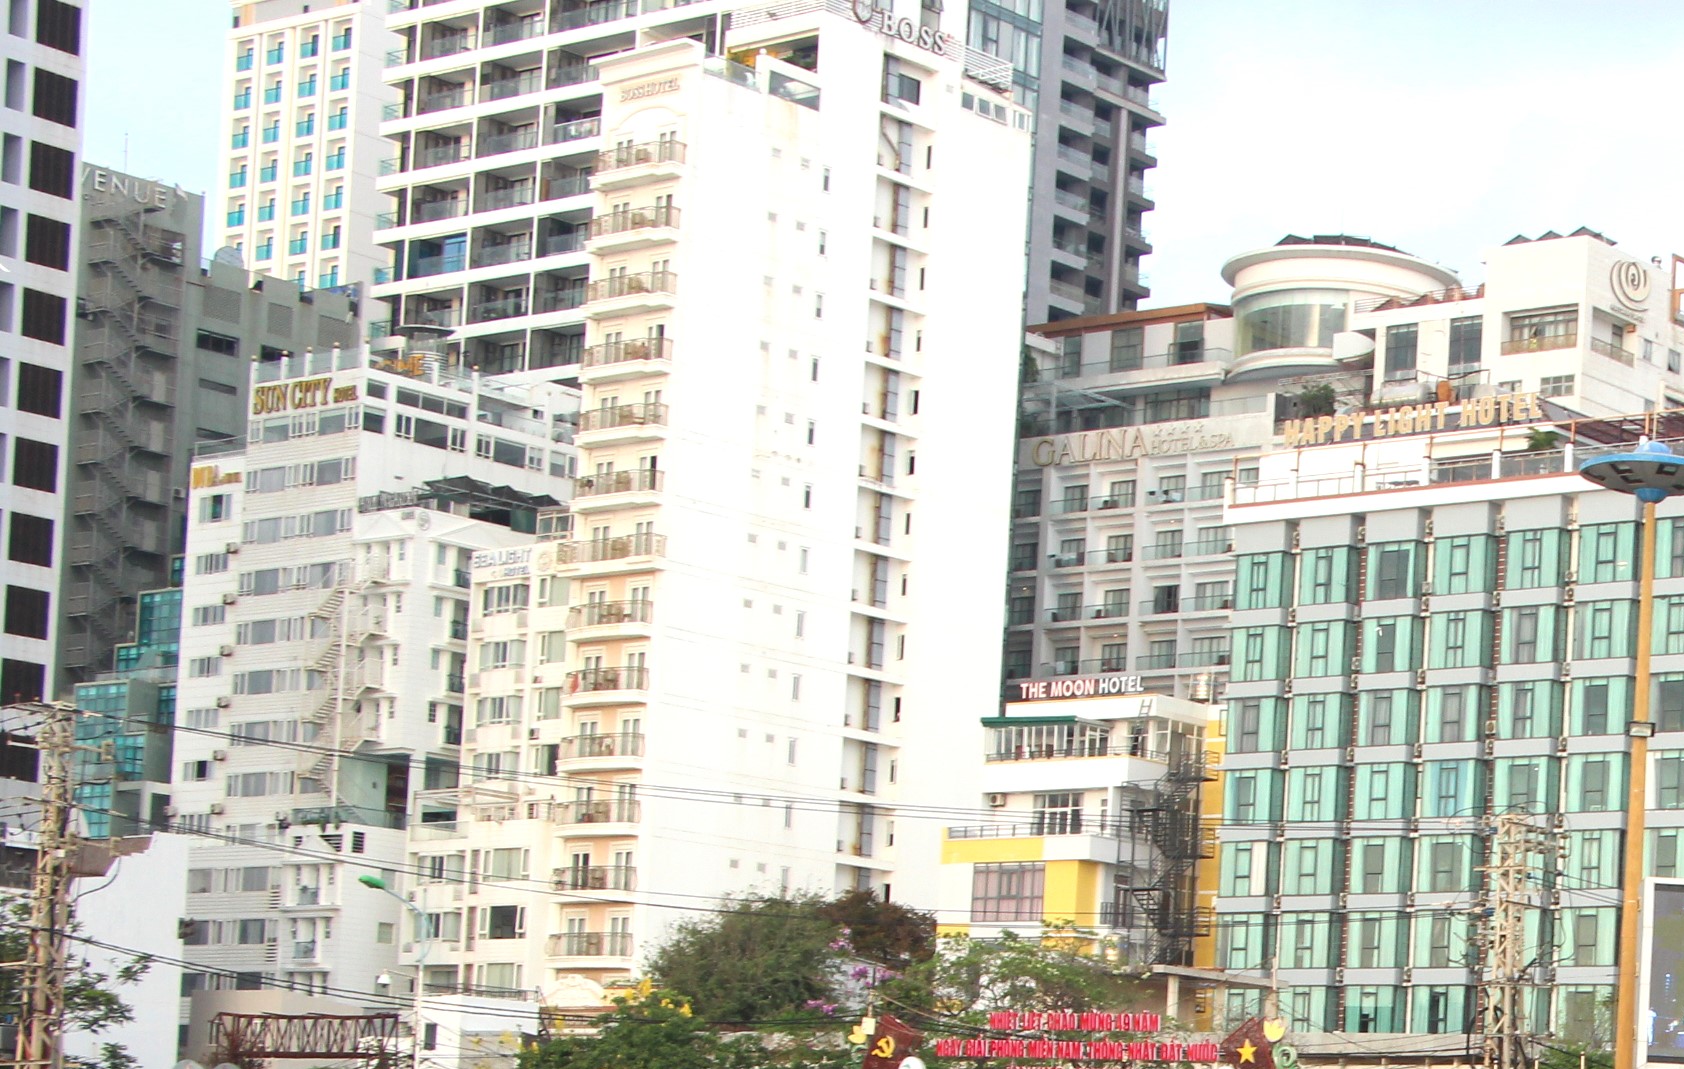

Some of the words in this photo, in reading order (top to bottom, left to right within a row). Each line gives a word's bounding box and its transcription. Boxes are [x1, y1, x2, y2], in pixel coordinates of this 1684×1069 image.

[880, 9, 945, 56] BOSS
[252, 384, 289, 415] SUN
[290, 376, 333, 410] CITY
[1284, 411, 1367, 449] HAPPY
[1373, 400, 1450, 438] LIGHT
[1459, 392, 1543, 428] HOTEL
[1032, 426, 1150, 468] GALINA
[473, 551, 498, 569] SEA
[1020, 682, 1048, 699] THE
[1050, 678, 1095, 698] MOON
[1098, 675, 1145, 695] HOTEL
